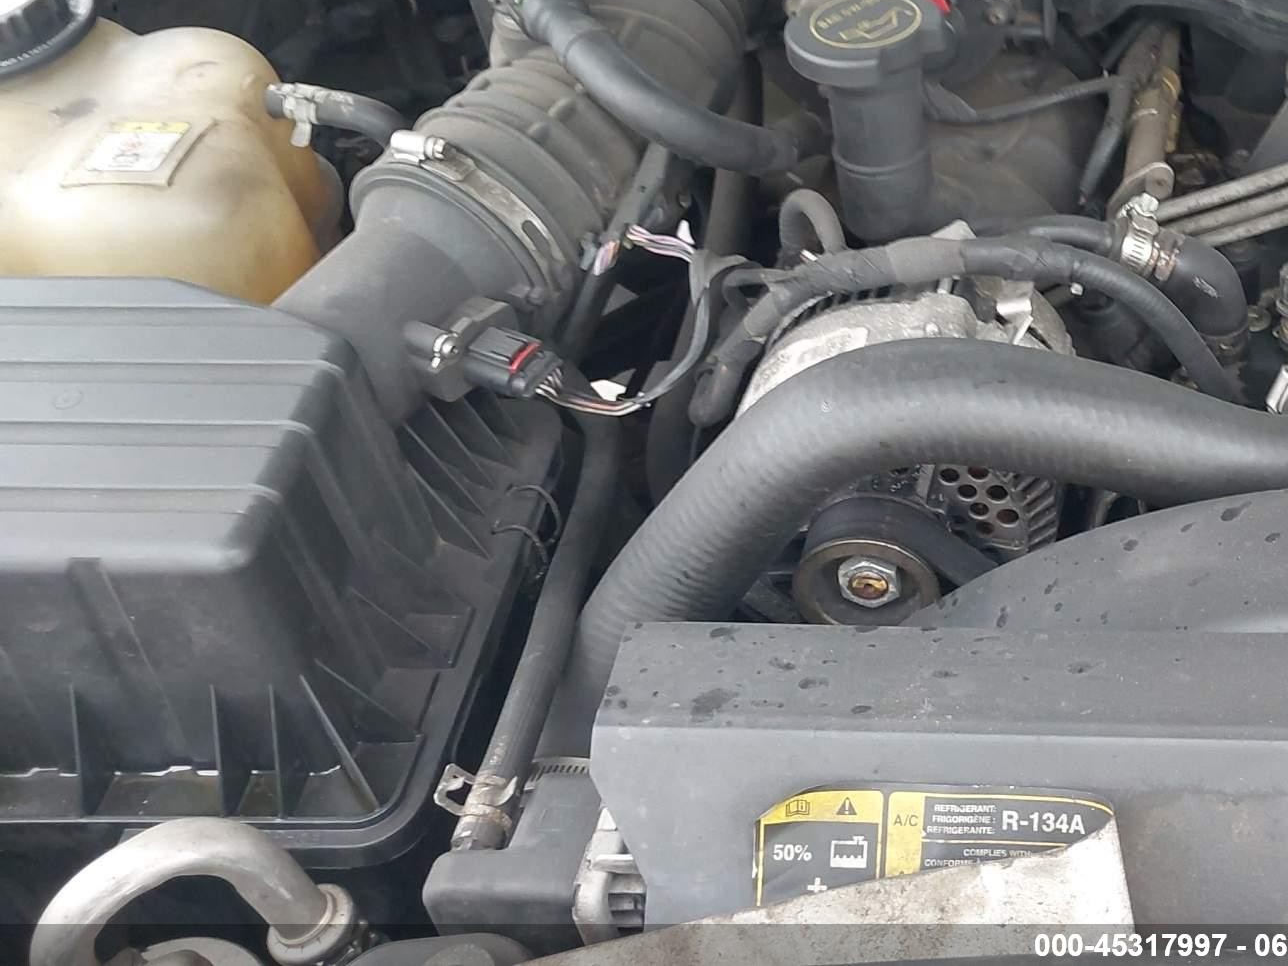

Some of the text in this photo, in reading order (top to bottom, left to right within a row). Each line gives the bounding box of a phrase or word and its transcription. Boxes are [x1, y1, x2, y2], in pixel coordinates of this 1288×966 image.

[934, 804, 997, 813] REFRIGERANT:
[893, 814, 919, 827] A/C
[1002, 810, 1086, 834] R-134A
[773, 844, 812, 861] 50%
[963, 848, 1007, 857] COMPLIES
